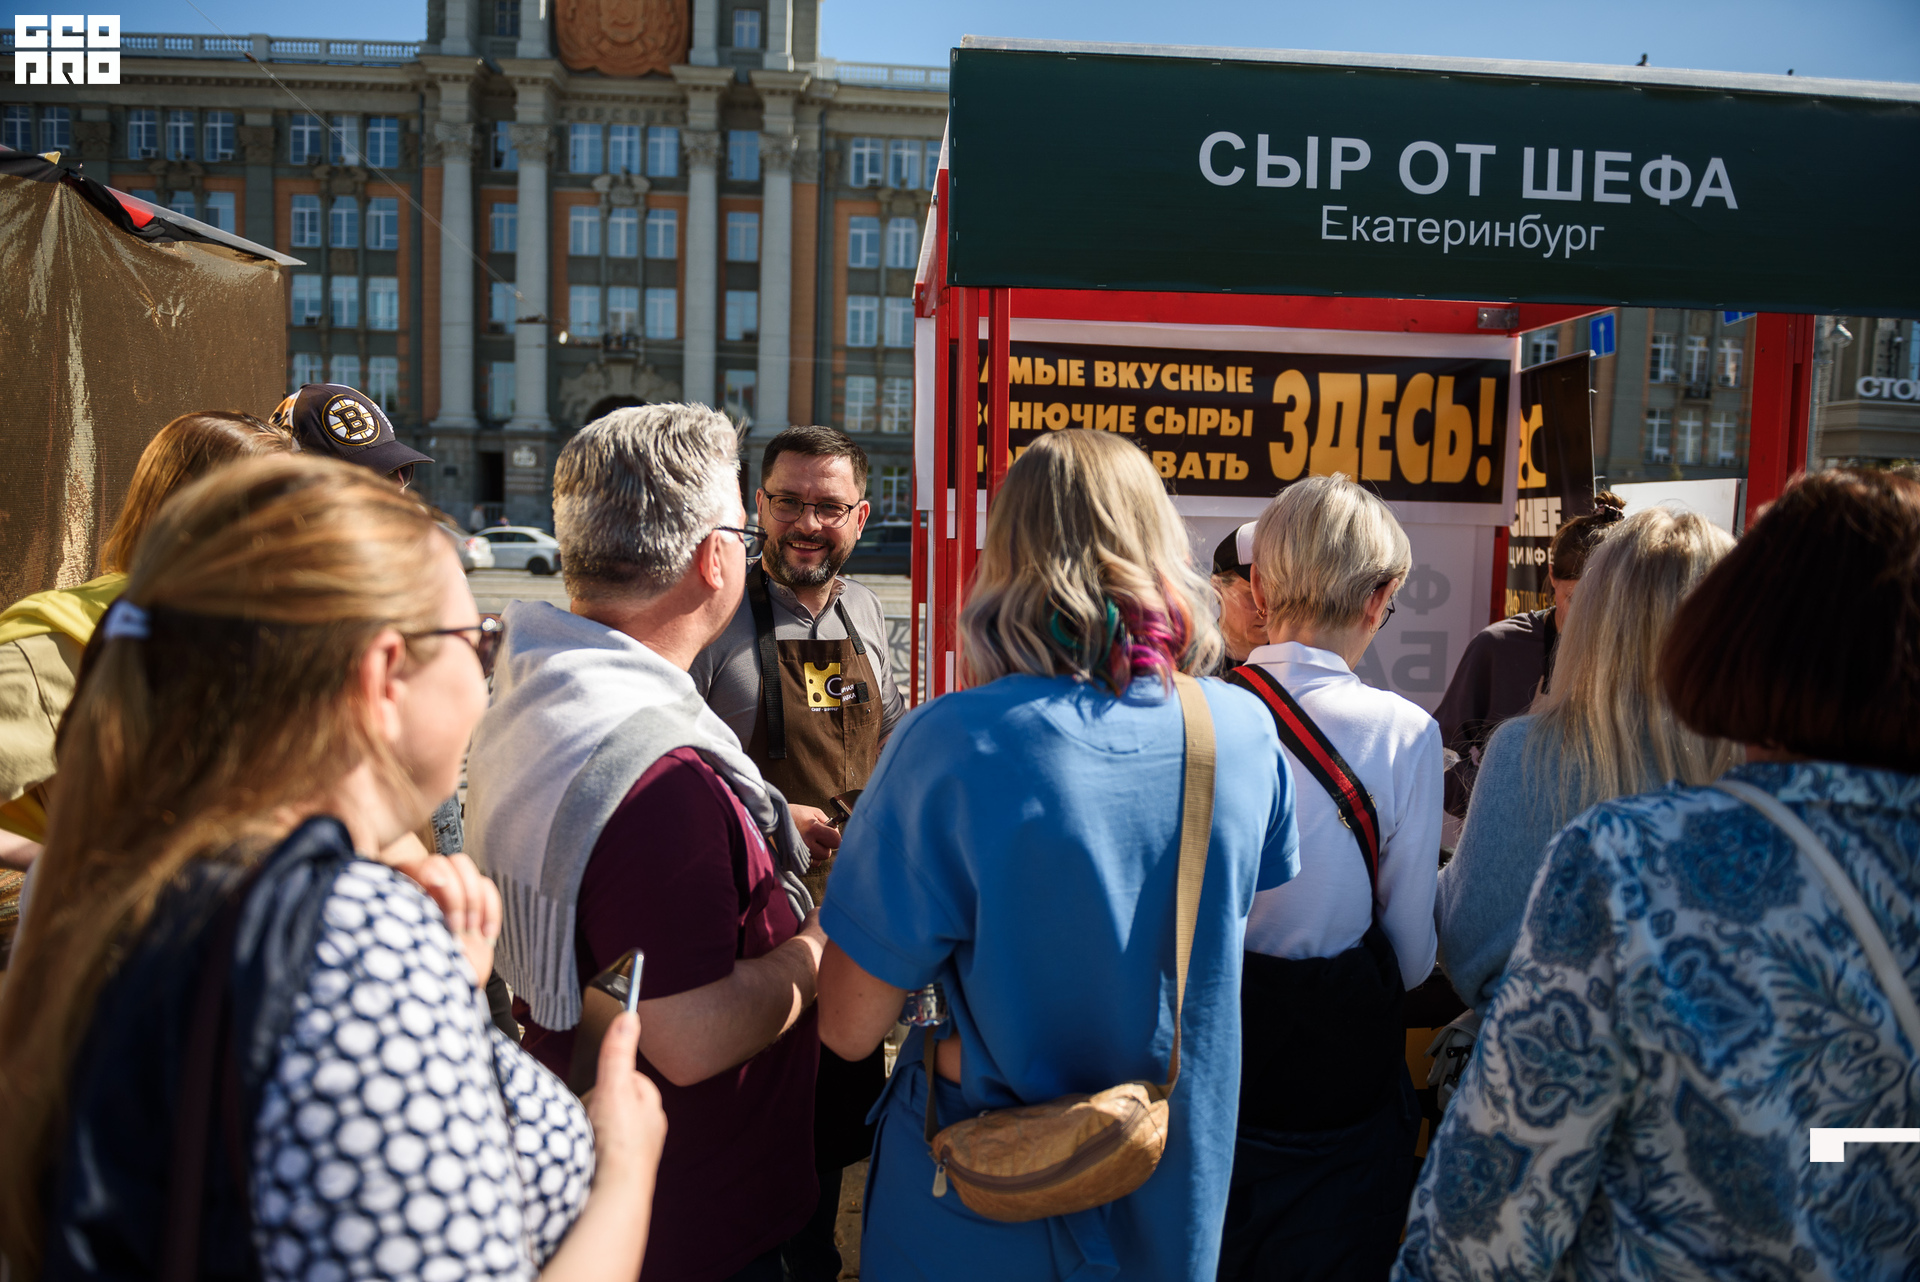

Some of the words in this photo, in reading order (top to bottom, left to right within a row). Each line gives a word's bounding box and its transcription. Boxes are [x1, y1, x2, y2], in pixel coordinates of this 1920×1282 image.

[1199, 131, 1371, 190] СЫР
[1399, 140, 1496, 196] ОТ
[1522, 147, 1738, 209] ШЕФА
[1321, 205, 1605, 259] Екатеринбург
[979, 356, 1085, 387] МЫЕ
[1094, 360, 1254, 393] ВКУСНЫЕ
[978, 401, 1137, 433] НЮЧИЕ
[1145, 406, 1254, 437] СЫРЫ
[1269, 369, 1496, 486] ЗДЕСЬ!
